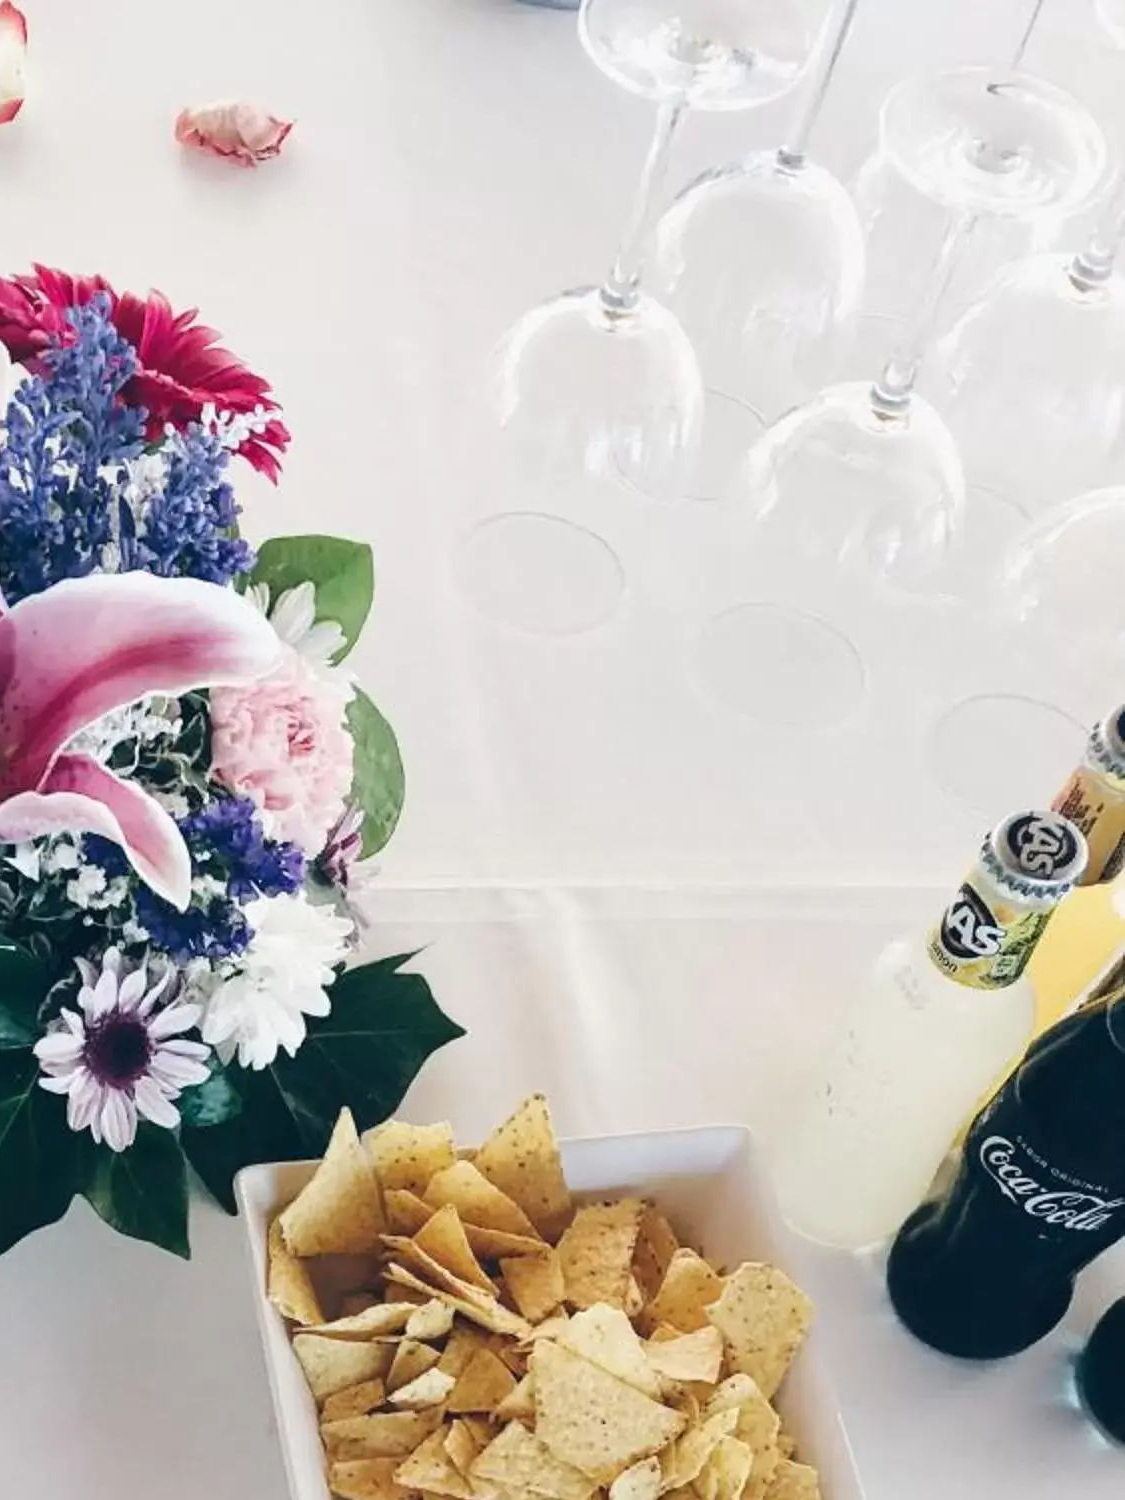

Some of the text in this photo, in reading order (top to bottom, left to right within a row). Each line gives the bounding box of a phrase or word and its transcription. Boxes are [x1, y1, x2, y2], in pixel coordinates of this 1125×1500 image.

[979, 1135, 1124, 1231] Coca-Cola
[1016, 1135, 1109, 1194] SABOR ORIGINAL
